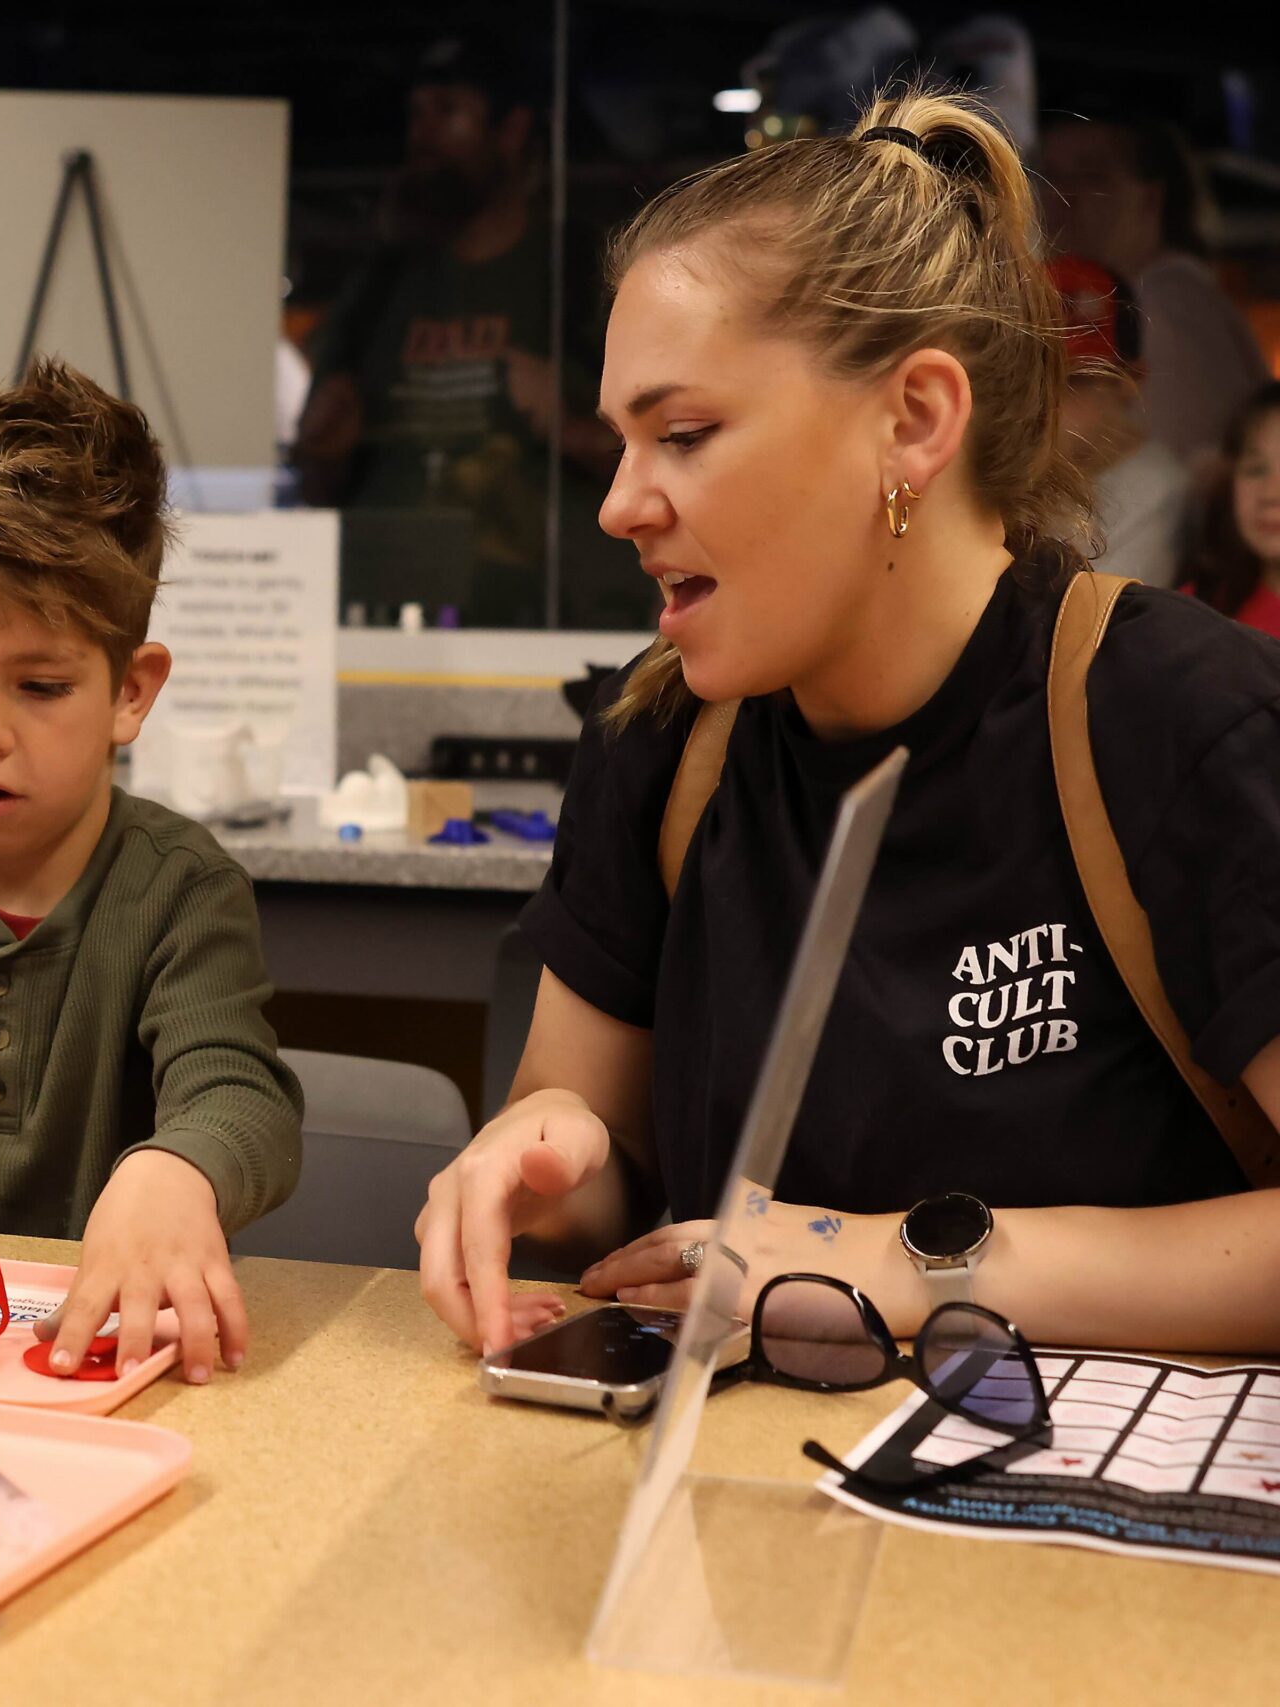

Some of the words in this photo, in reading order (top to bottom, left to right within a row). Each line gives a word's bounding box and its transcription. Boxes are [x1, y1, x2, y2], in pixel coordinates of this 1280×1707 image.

[951, 923, 1084, 985] ANTI-
[947, 969, 1076, 1030] CULT
[942, 1019, 1079, 1076] CLUB
